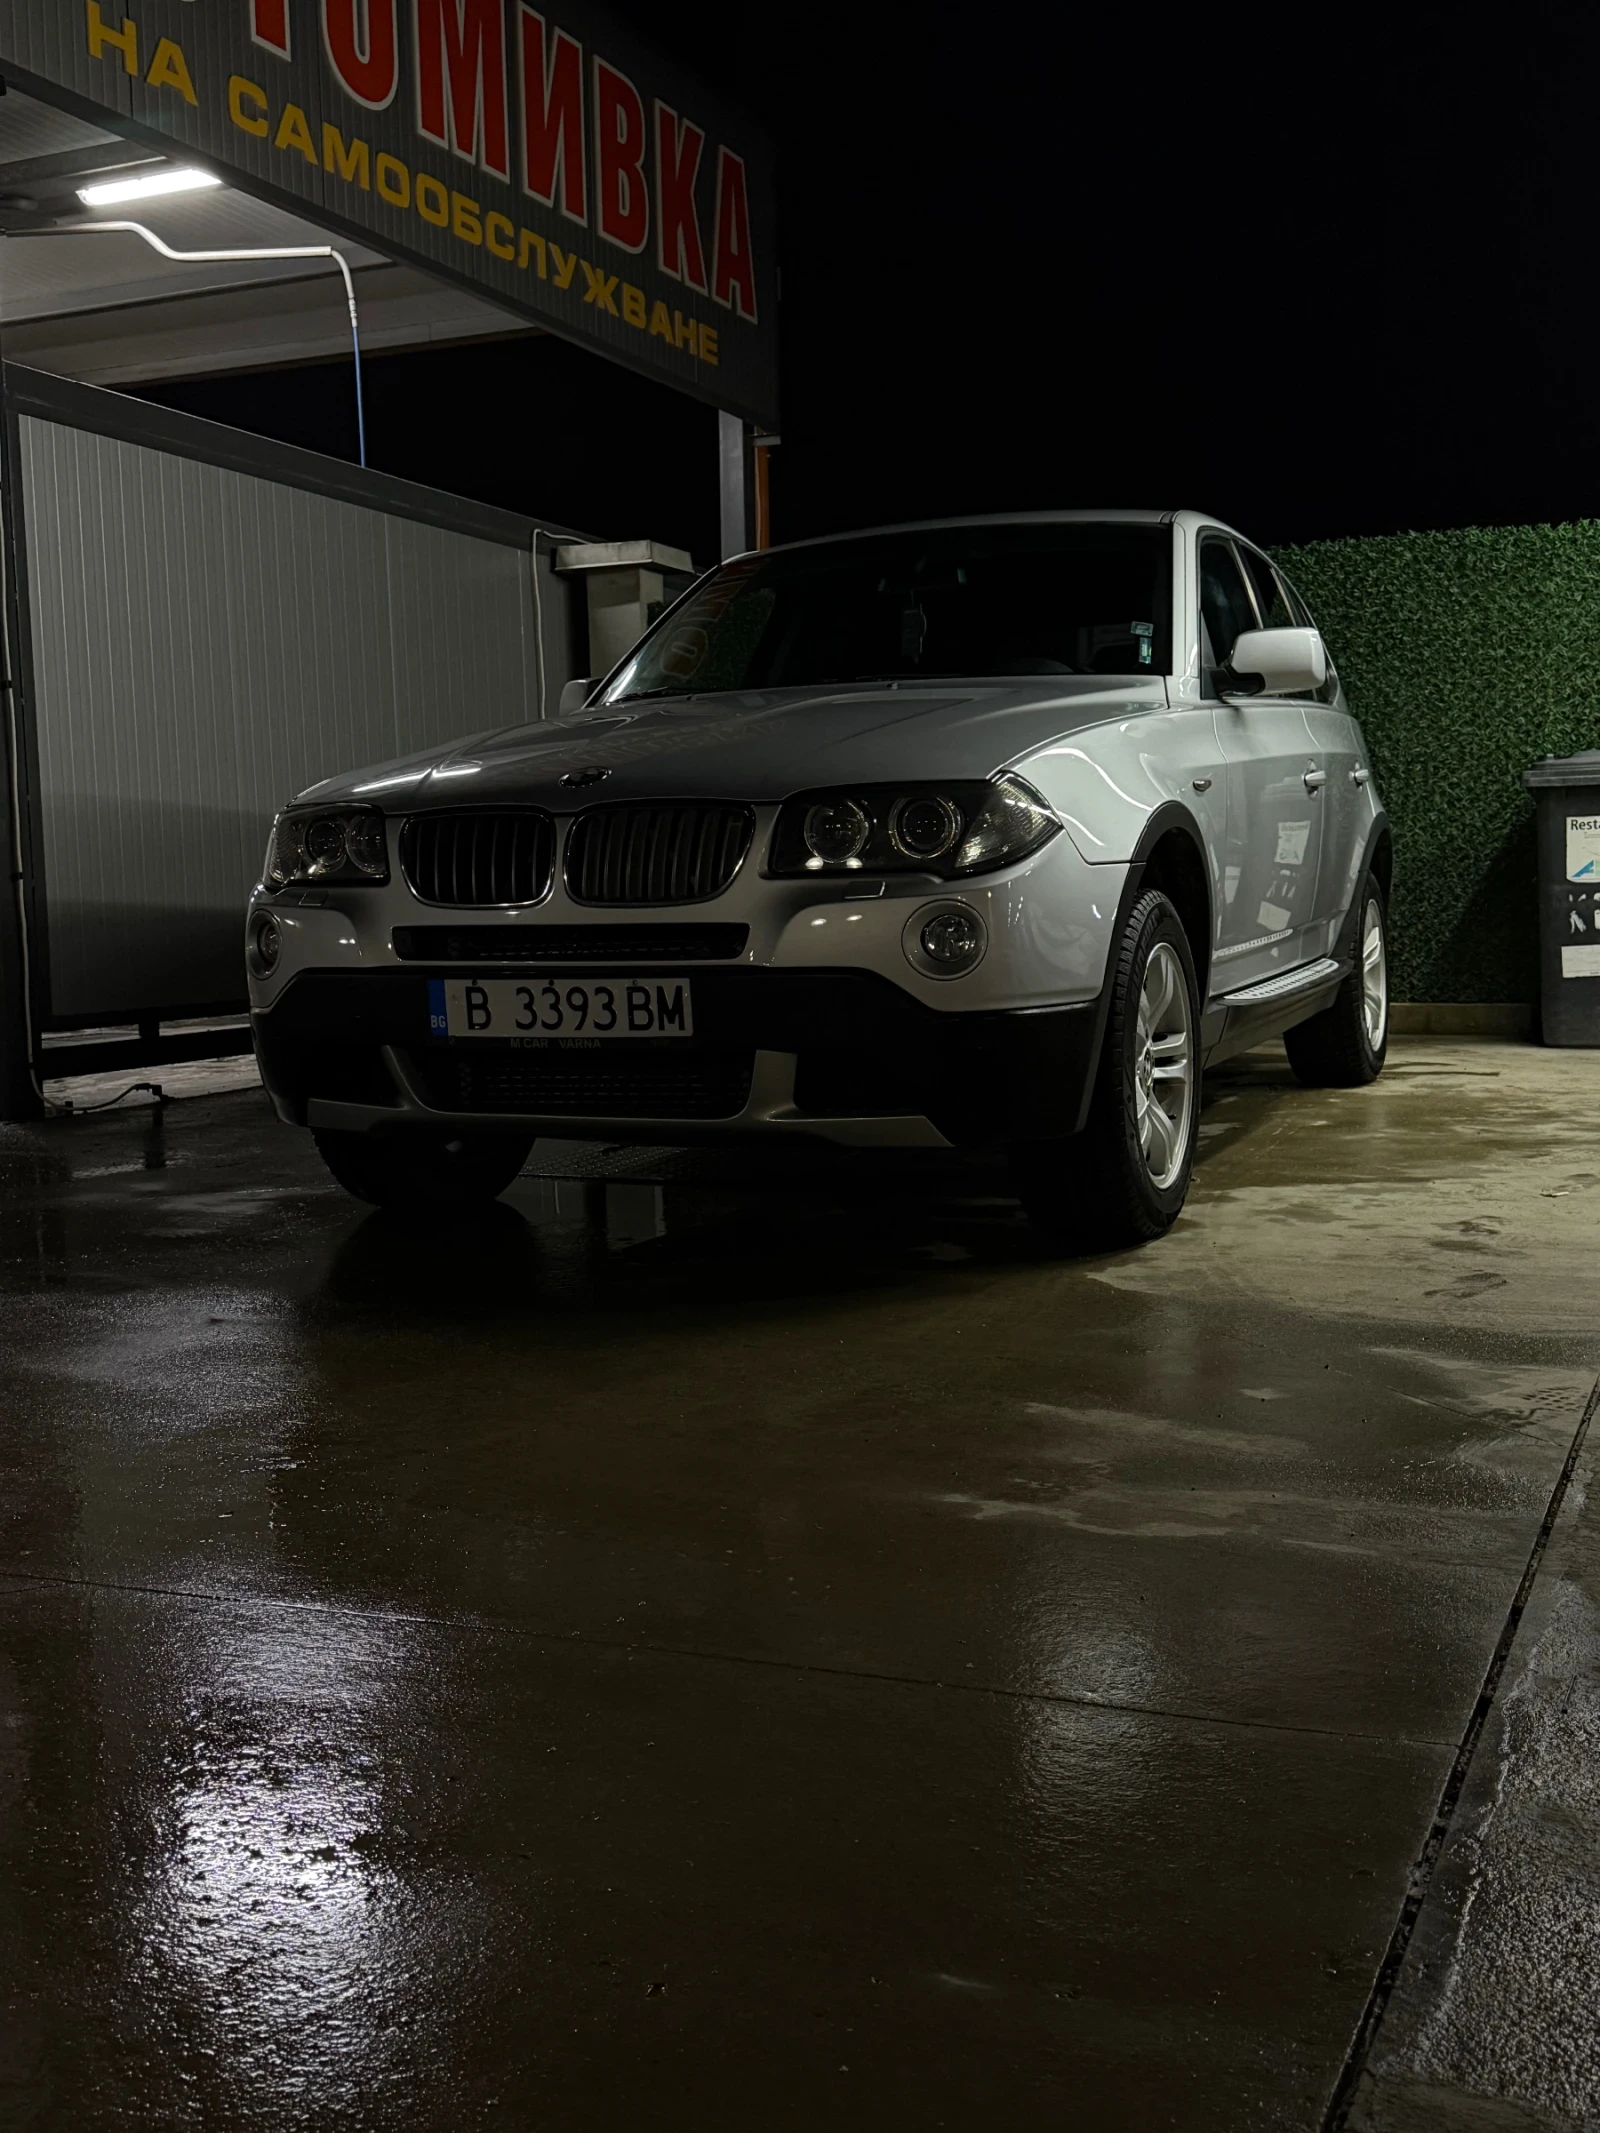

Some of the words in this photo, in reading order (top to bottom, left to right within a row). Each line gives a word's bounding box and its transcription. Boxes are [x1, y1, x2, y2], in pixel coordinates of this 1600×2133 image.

[86, 0, 199, 106] НА
[228, 74, 720, 366] САМООБСЛУЖВАНЕ
[1570, 818, 1600, 831] Rest
[430, 1015, 446, 1028] BG
[523, 1038, 549, 1048] CAR
[559, 1038, 602, 1049] VARNA
